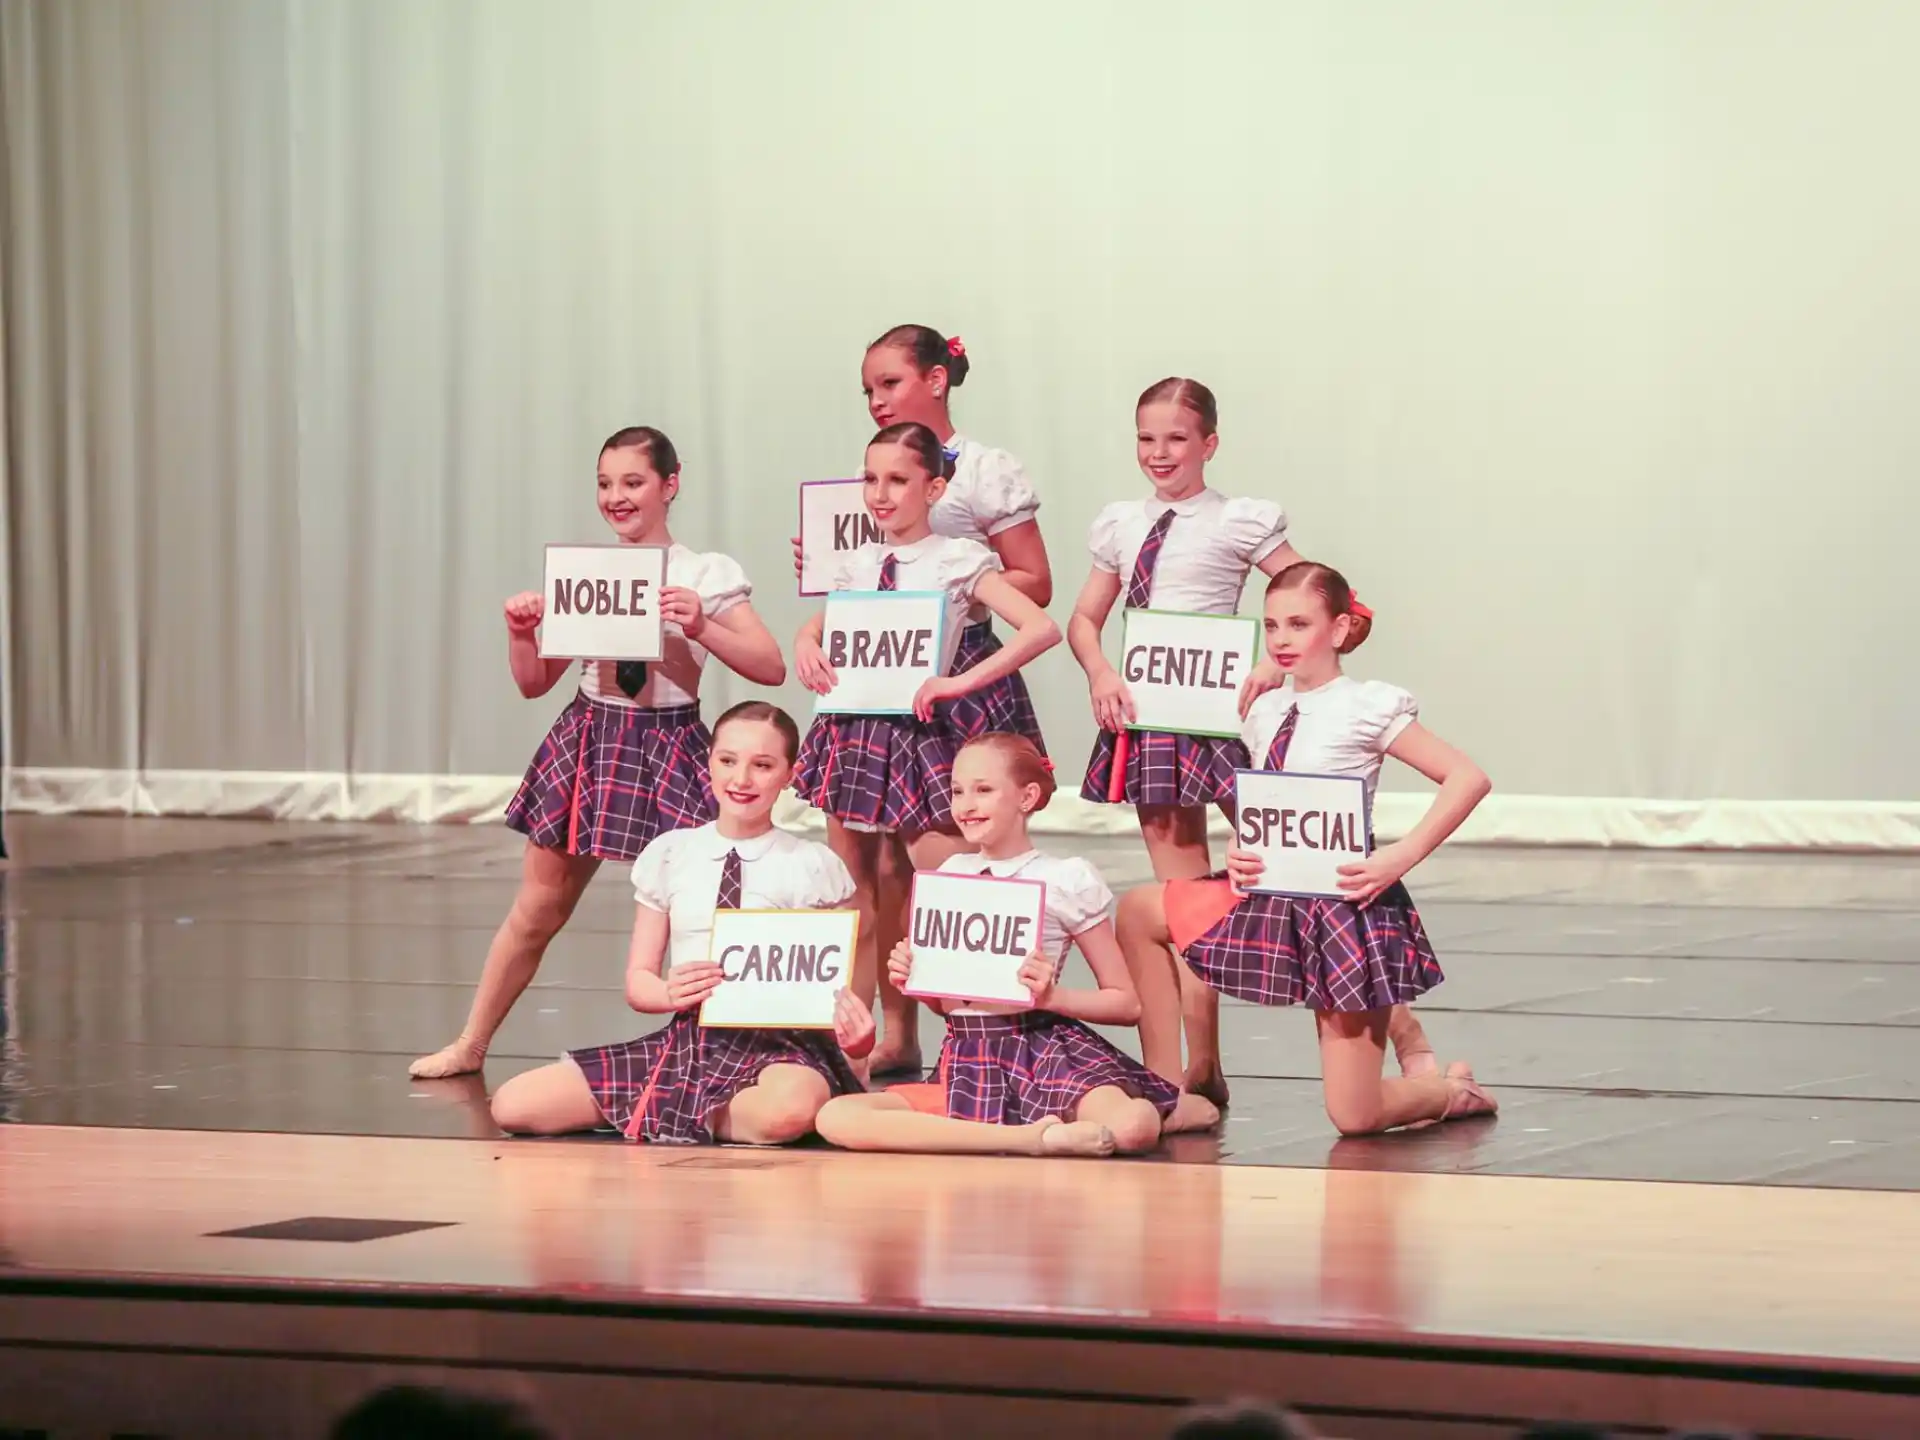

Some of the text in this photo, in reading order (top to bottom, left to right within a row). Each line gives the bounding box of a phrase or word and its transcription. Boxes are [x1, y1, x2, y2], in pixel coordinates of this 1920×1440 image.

[834, 513, 887, 550] KIN
[554, 578, 649, 616] NOBLE
[828, 629, 931, 668] BRAVE
[1125, 645, 1239, 689] GENTLE
[1240, 807, 1365, 853] SPECIAL
[913, 907, 1032, 956] UNIQUE
[719, 944, 841, 982] CARING
